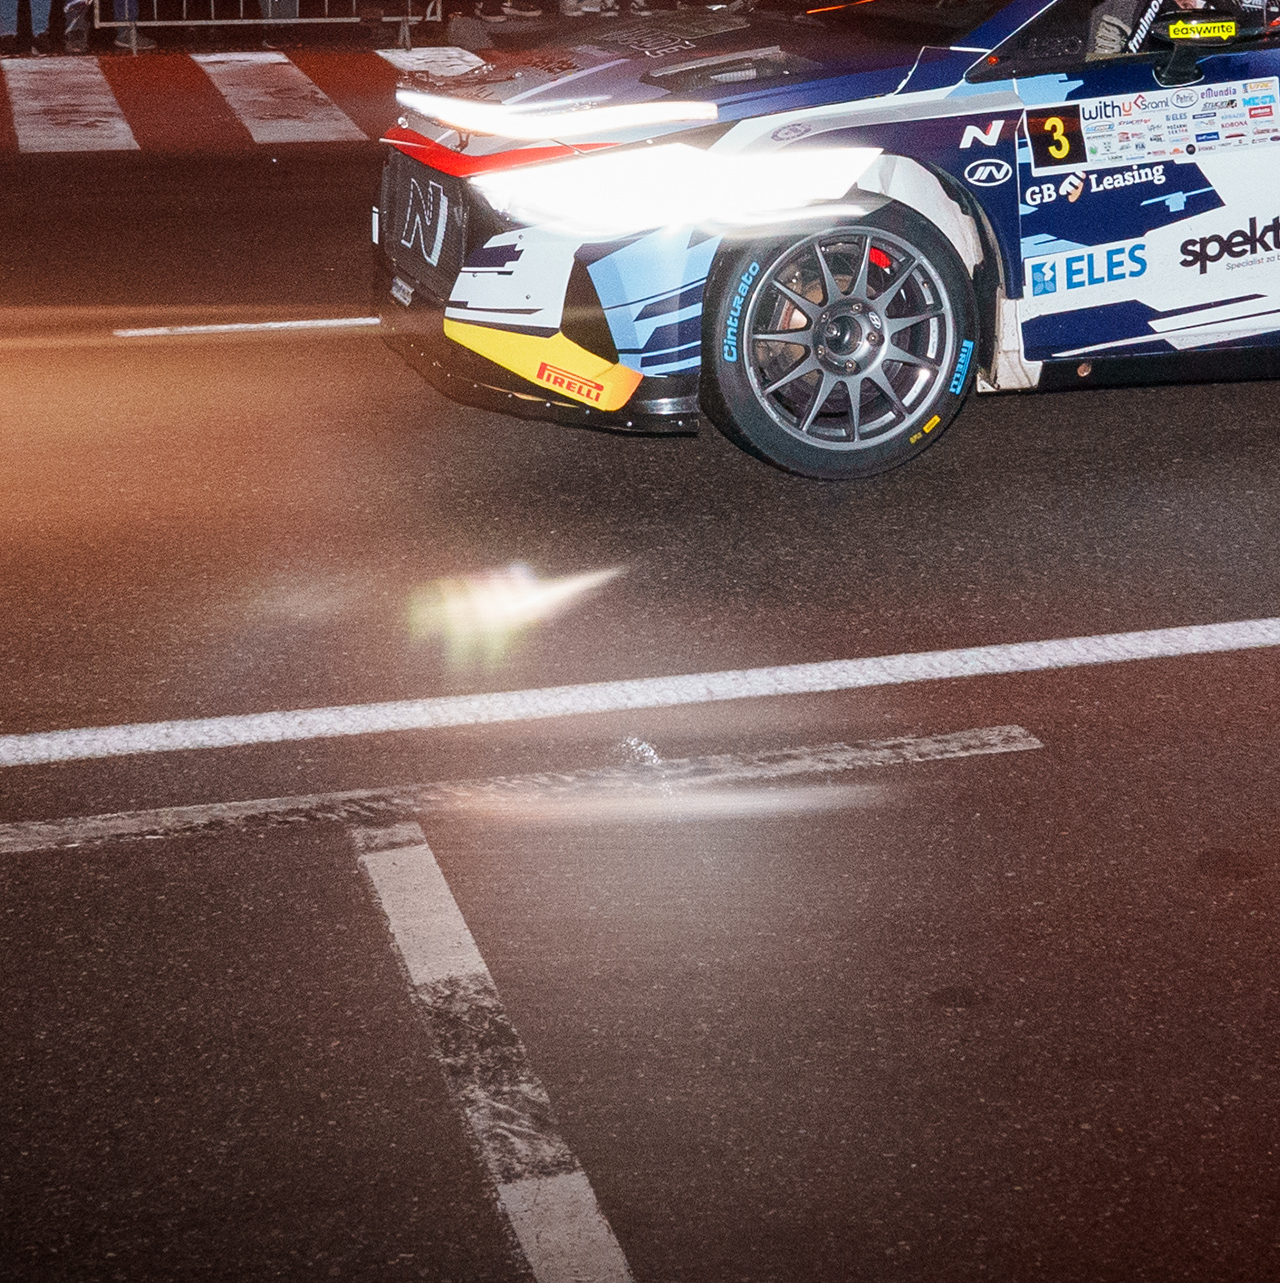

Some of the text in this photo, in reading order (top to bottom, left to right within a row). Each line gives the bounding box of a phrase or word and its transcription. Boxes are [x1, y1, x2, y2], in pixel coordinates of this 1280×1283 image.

[1172, 24, 1234, 38] easywrite
[959, 120, 1005, 148] N
[1043, 116, 1070, 159] 3
[1025, 164, 1166, 206] GB Leasing
[401, 177, 449, 268] N
[1065, 243, 1148, 291] ELES
[1226, 257, 1264, 271] Specialist
[536, 361, 605, 403] PIRELLI
